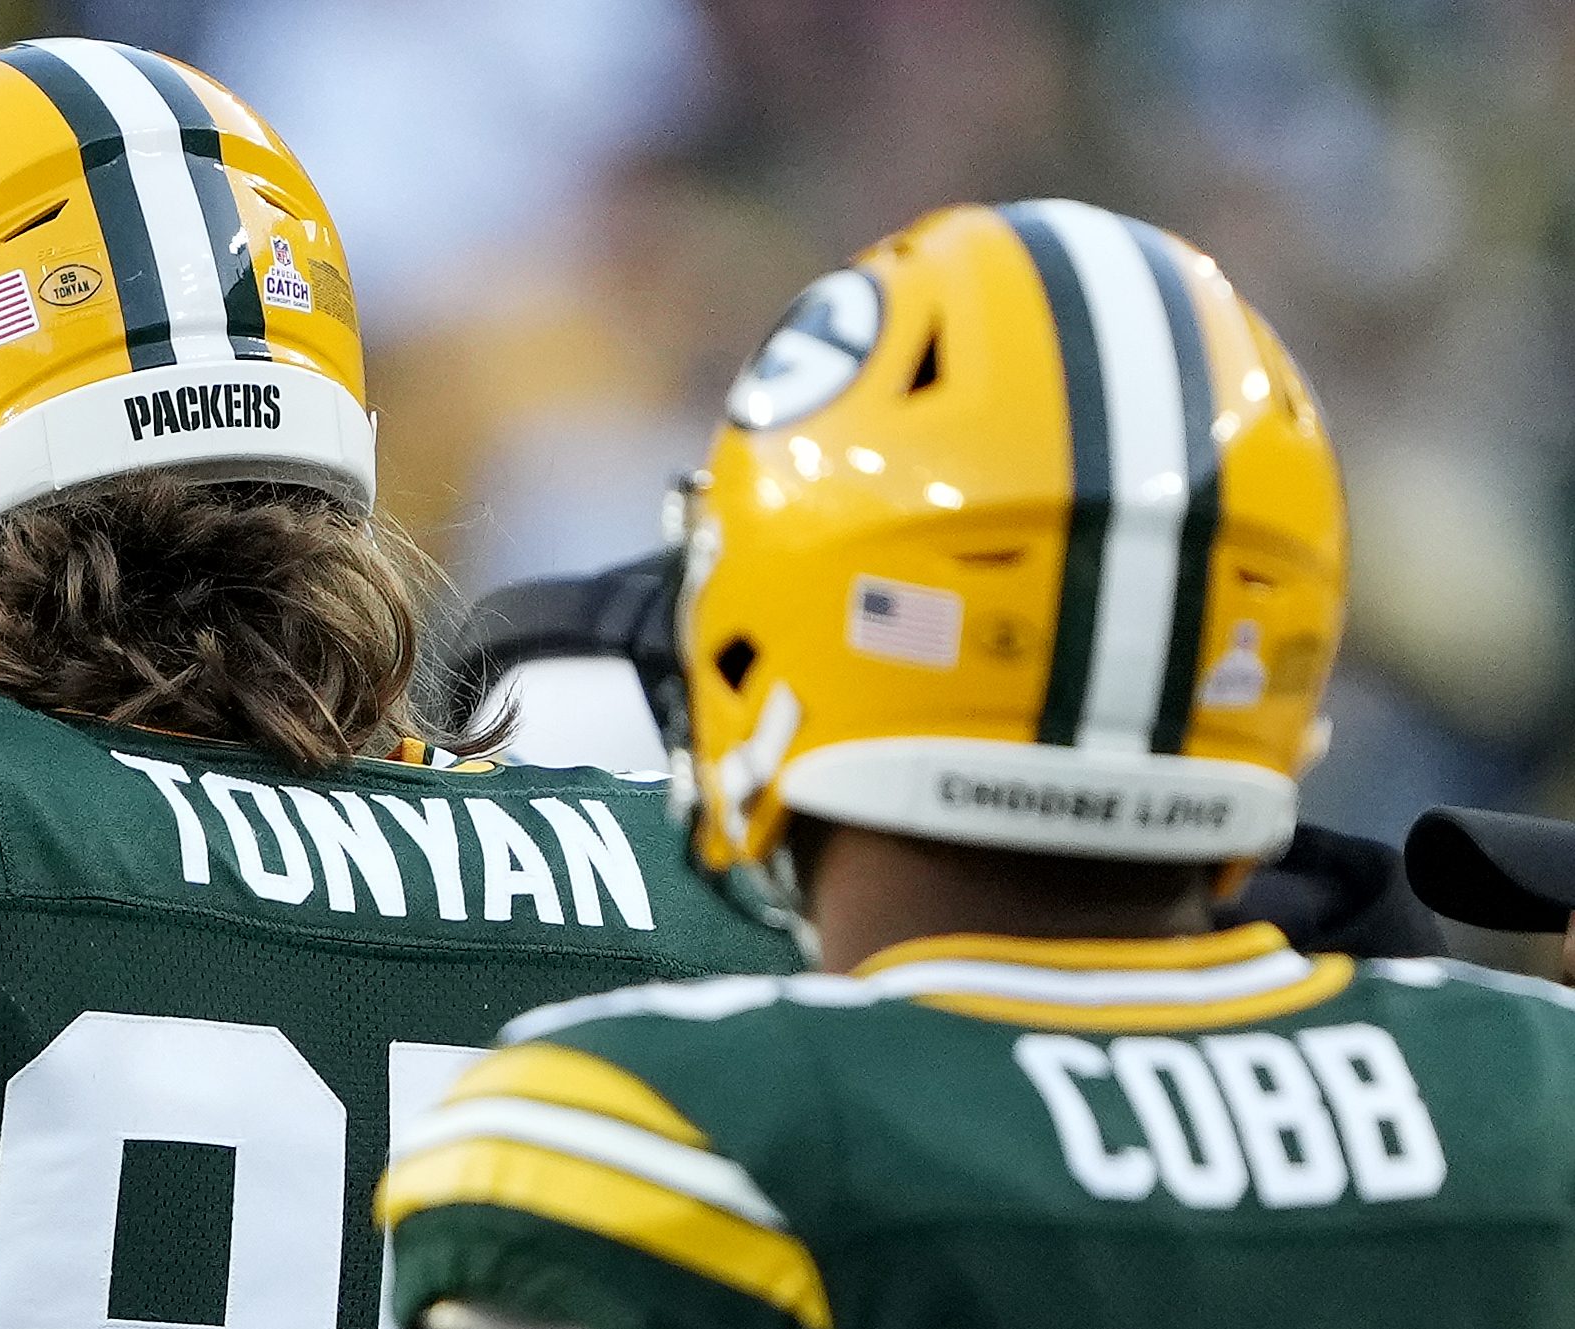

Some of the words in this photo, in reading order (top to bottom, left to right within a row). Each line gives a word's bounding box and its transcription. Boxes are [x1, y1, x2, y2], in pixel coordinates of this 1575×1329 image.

[60, 271, 77, 285] 85
[272, 267, 302, 282] CRUCIAL
[53, 280, 91, 300] TONYAN
[266, 276, 310, 301] CATCH
[123, 383, 281, 442] PACKERS
[110, 750, 657, 931] TONYAN
[1012, 1021, 1449, 1210] COBB
